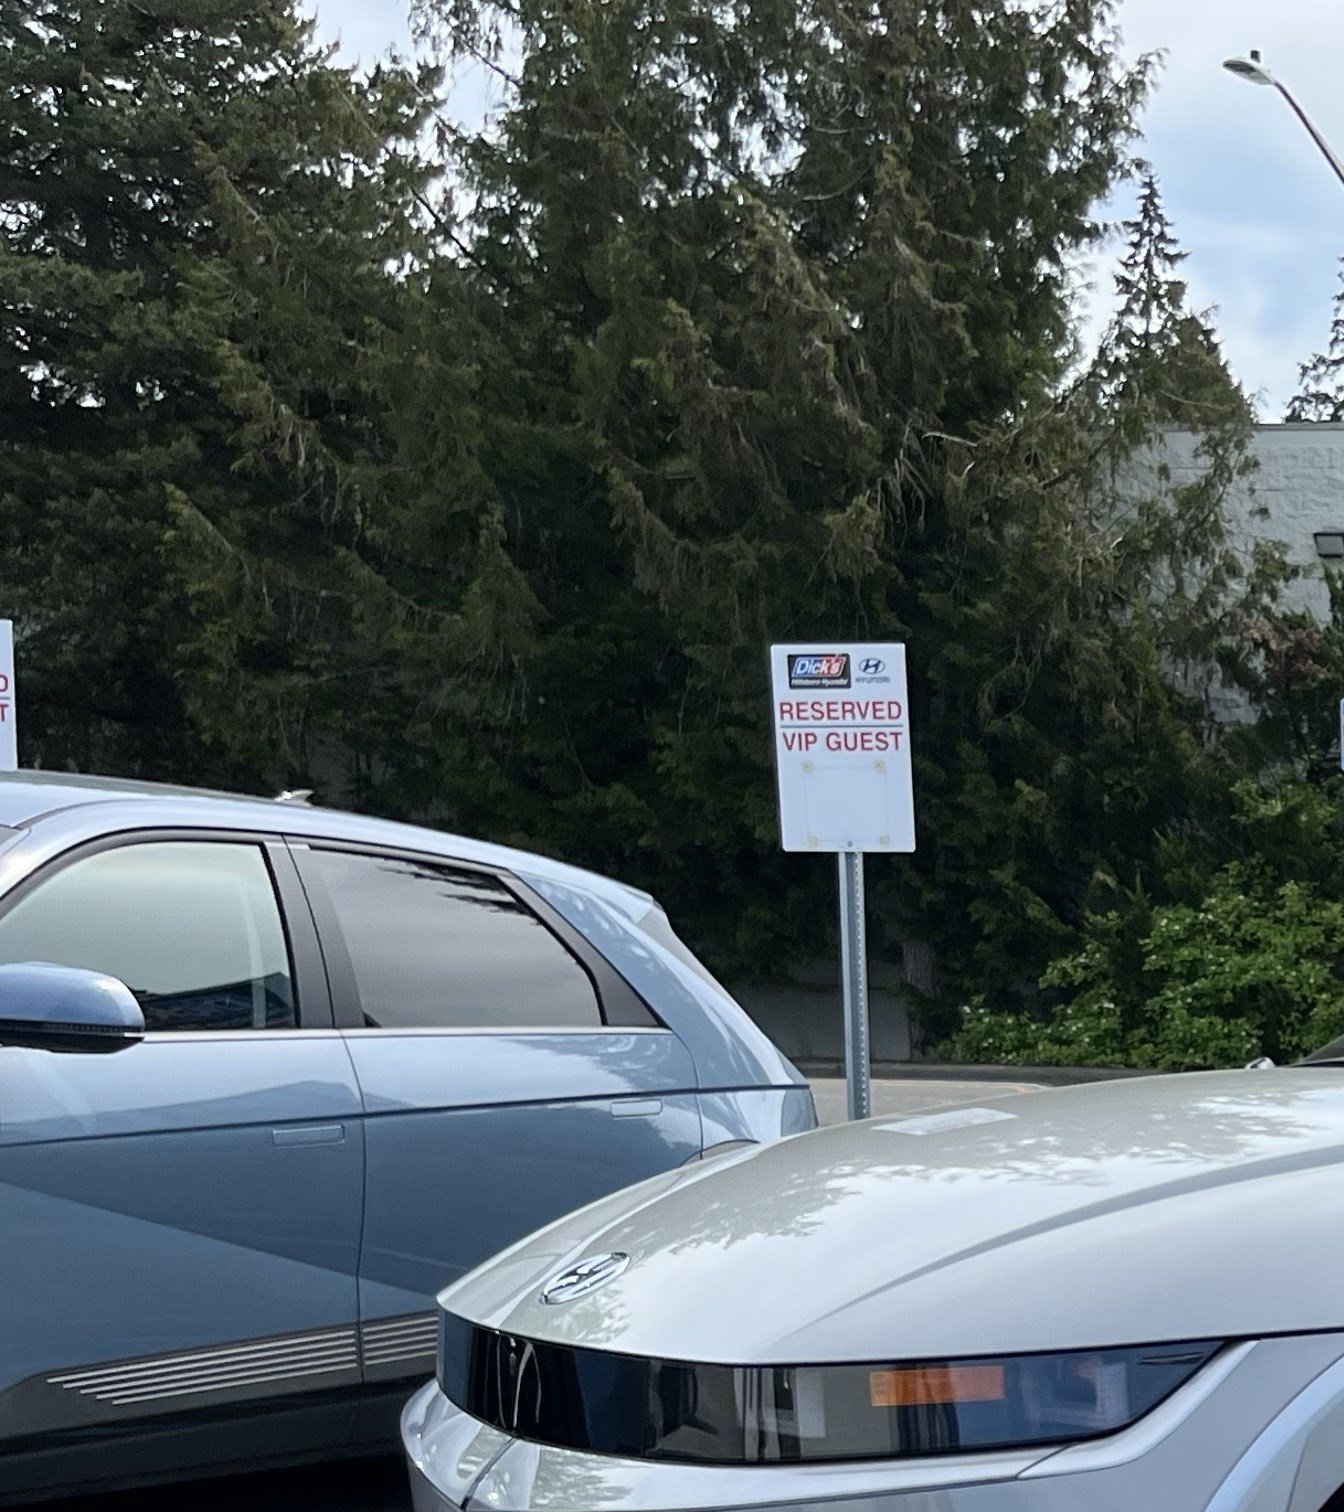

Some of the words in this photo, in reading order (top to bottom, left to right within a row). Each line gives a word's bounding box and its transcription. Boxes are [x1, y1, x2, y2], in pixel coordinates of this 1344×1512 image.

[780, 701, 902, 721] RESERVED
[783, 733, 817, 751] VIP
[826, 732, 903, 751] GUEST
